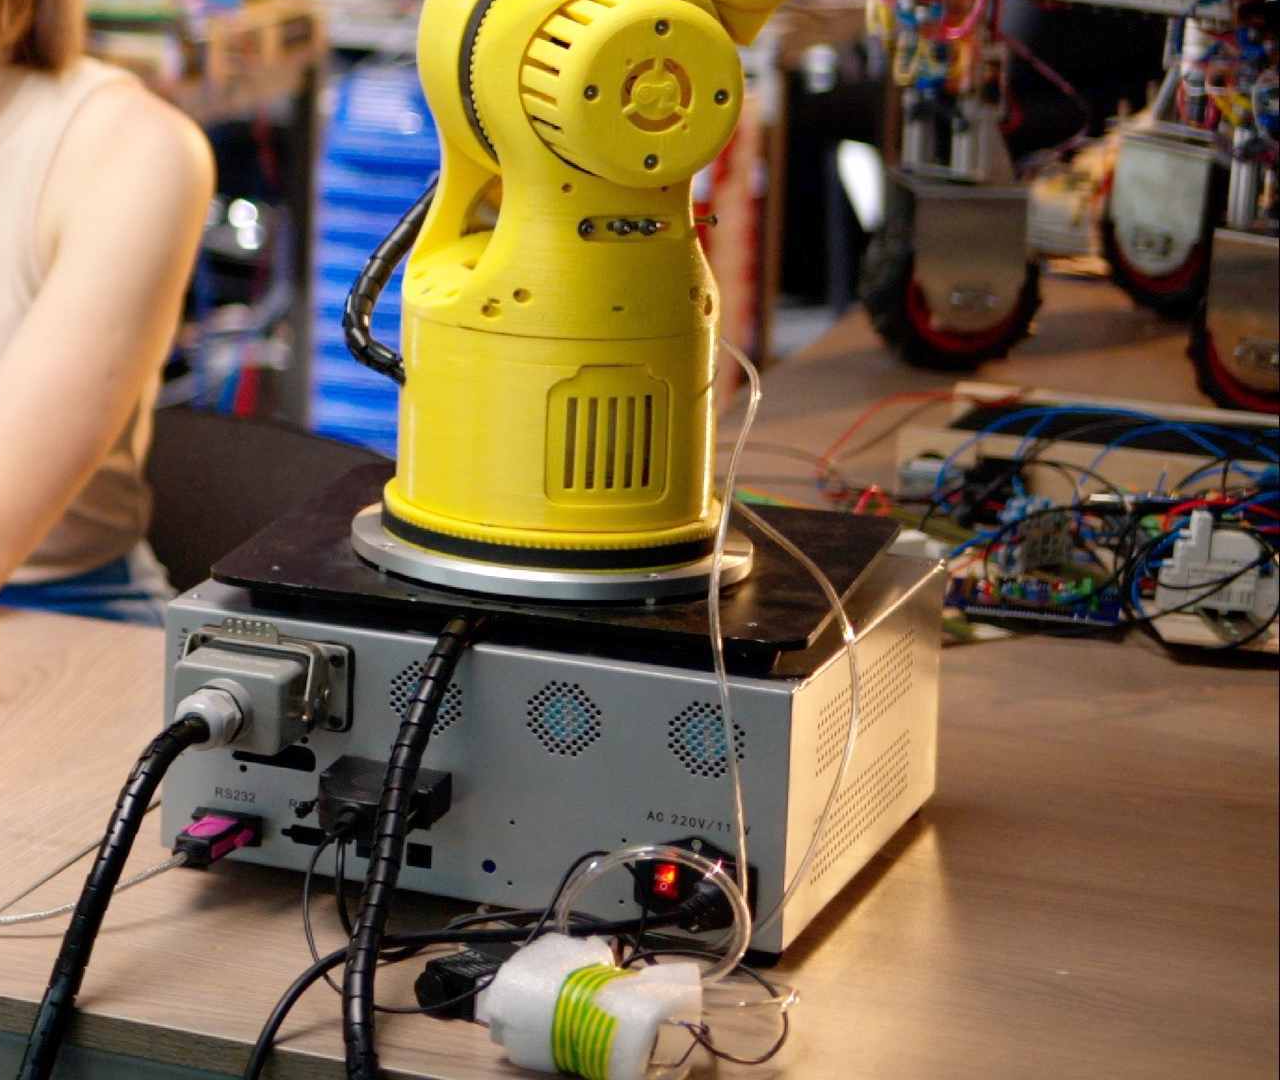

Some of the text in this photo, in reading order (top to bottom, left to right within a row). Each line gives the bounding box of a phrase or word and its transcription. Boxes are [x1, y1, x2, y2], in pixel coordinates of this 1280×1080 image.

[214, 786, 257, 804] RS232
[646, 811, 751, 836] AC 220V/11V
